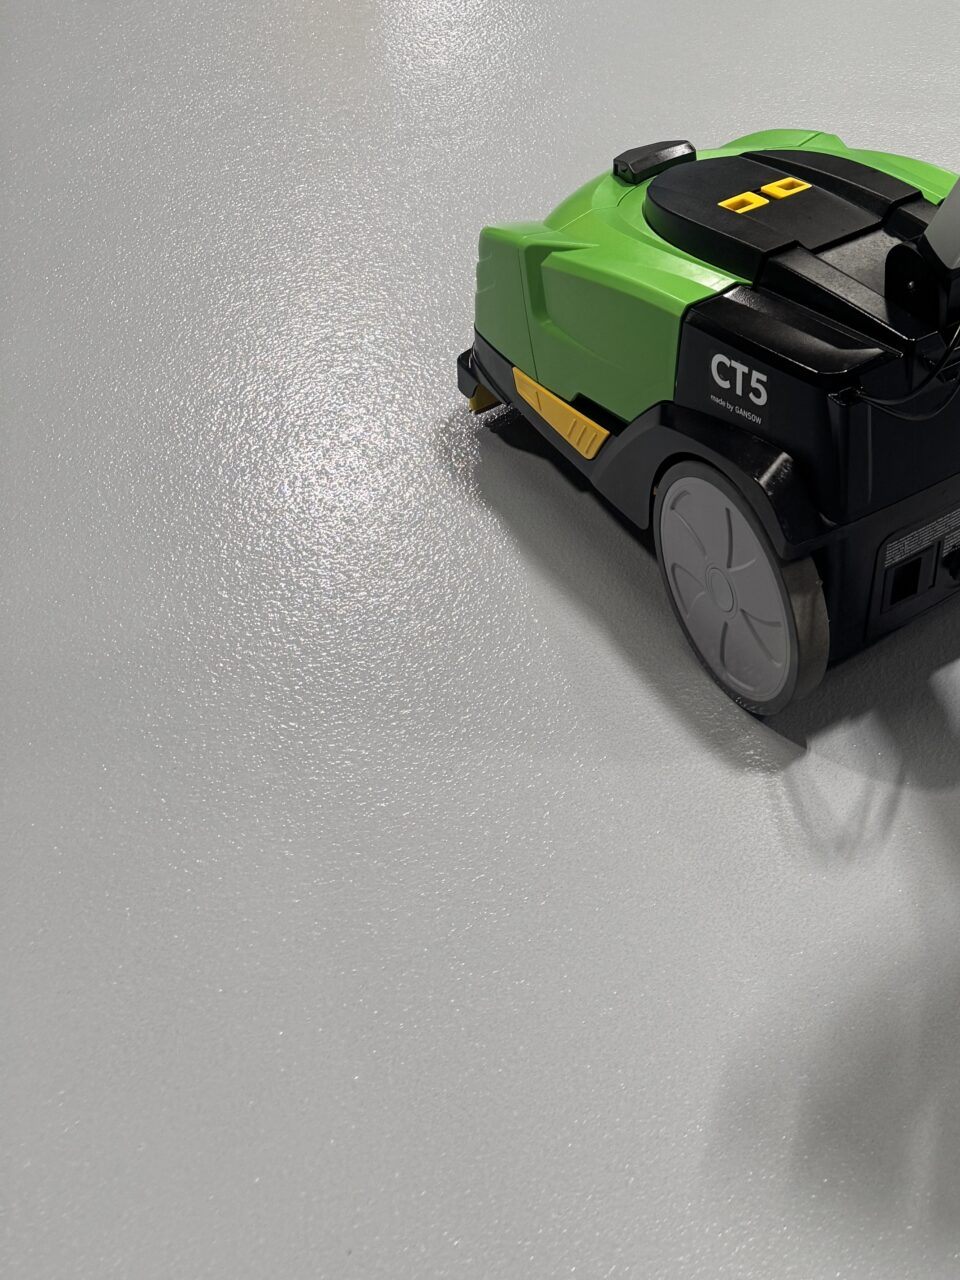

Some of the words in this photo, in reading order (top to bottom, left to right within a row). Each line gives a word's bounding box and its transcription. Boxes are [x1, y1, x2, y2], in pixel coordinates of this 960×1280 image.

[711, 353, 768, 407] CT5
[710, 394, 727, 408] made
[726, 401, 735, 413] by
[734, 405, 763, 426] GANSOW
